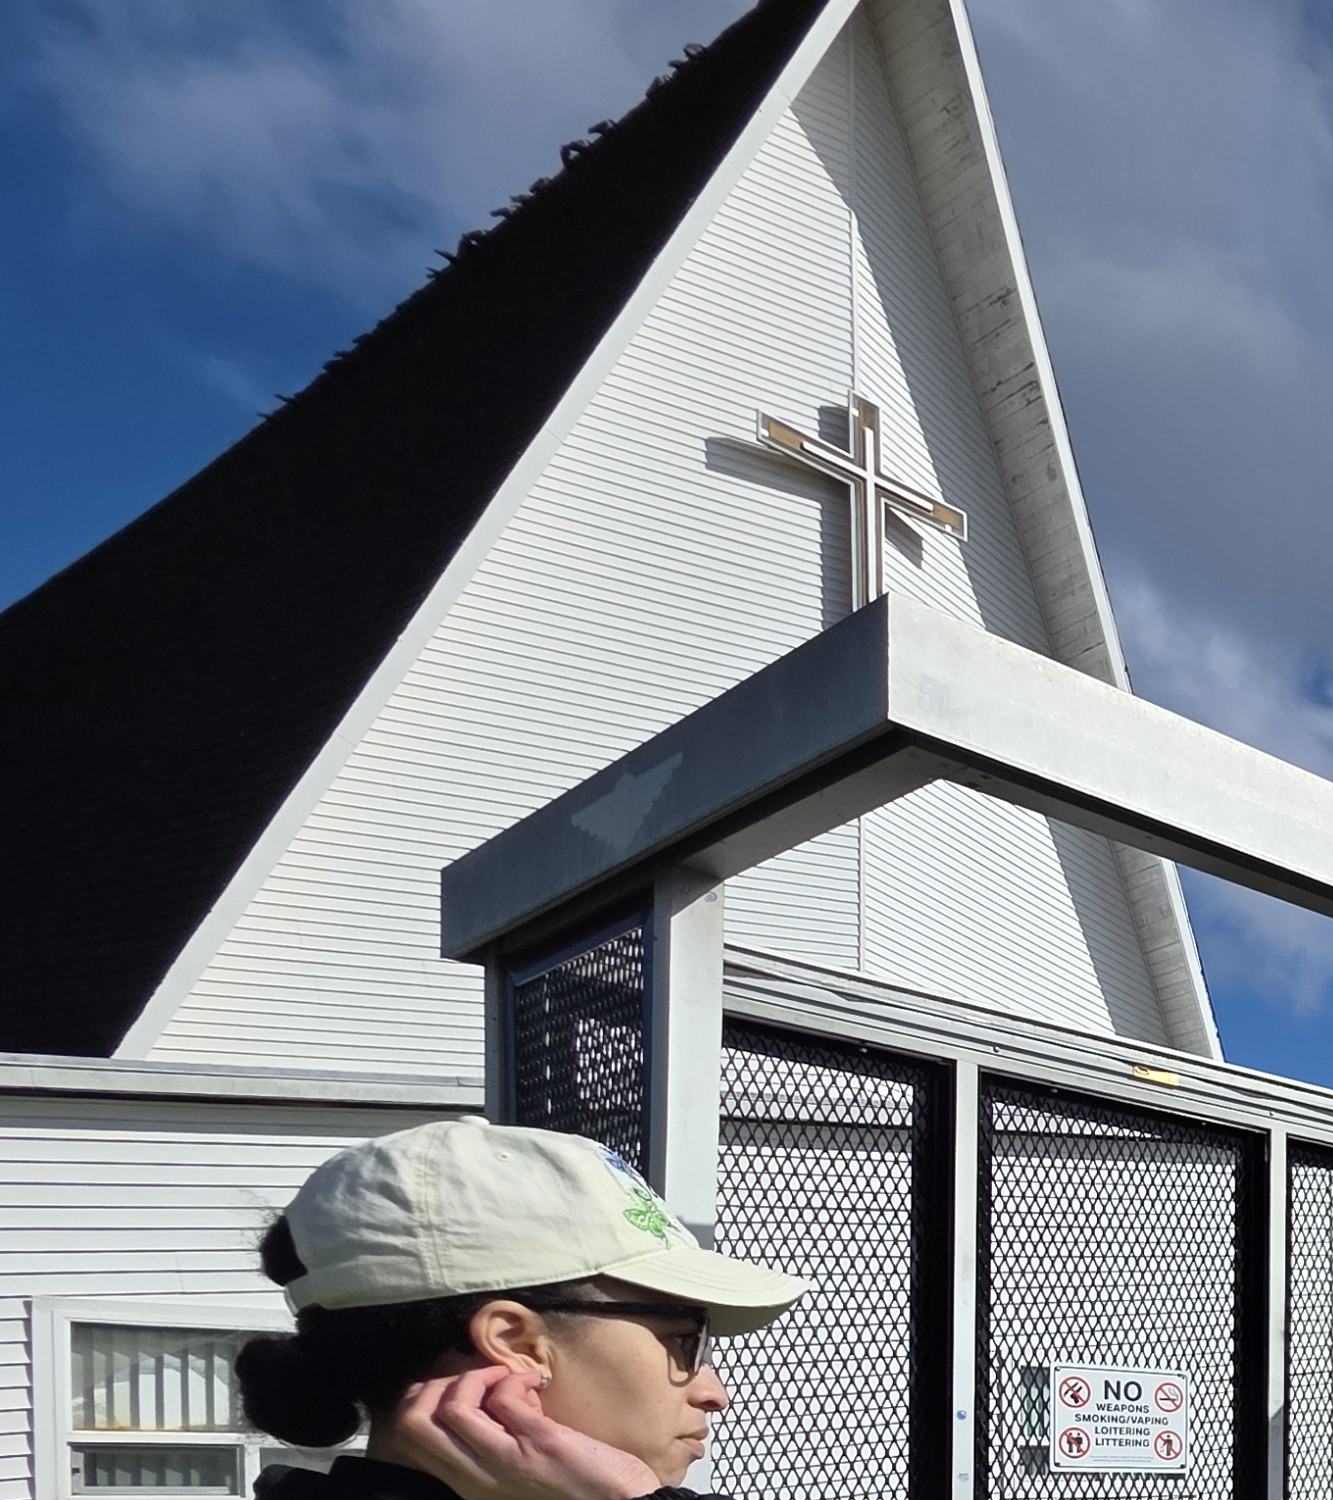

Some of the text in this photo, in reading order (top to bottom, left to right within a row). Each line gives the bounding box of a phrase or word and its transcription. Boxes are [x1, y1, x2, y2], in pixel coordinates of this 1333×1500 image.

[1104, 1380, 1143, 1402] NO
[1096, 1403, 1150, 1413] WEAPONS
[1074, 1413, 1169, 1426] SMOKING/VAPING
[1094, 1426, 1151, 1436] LOITERING
[1095, 1438, 1150, 1447] LITTERING
